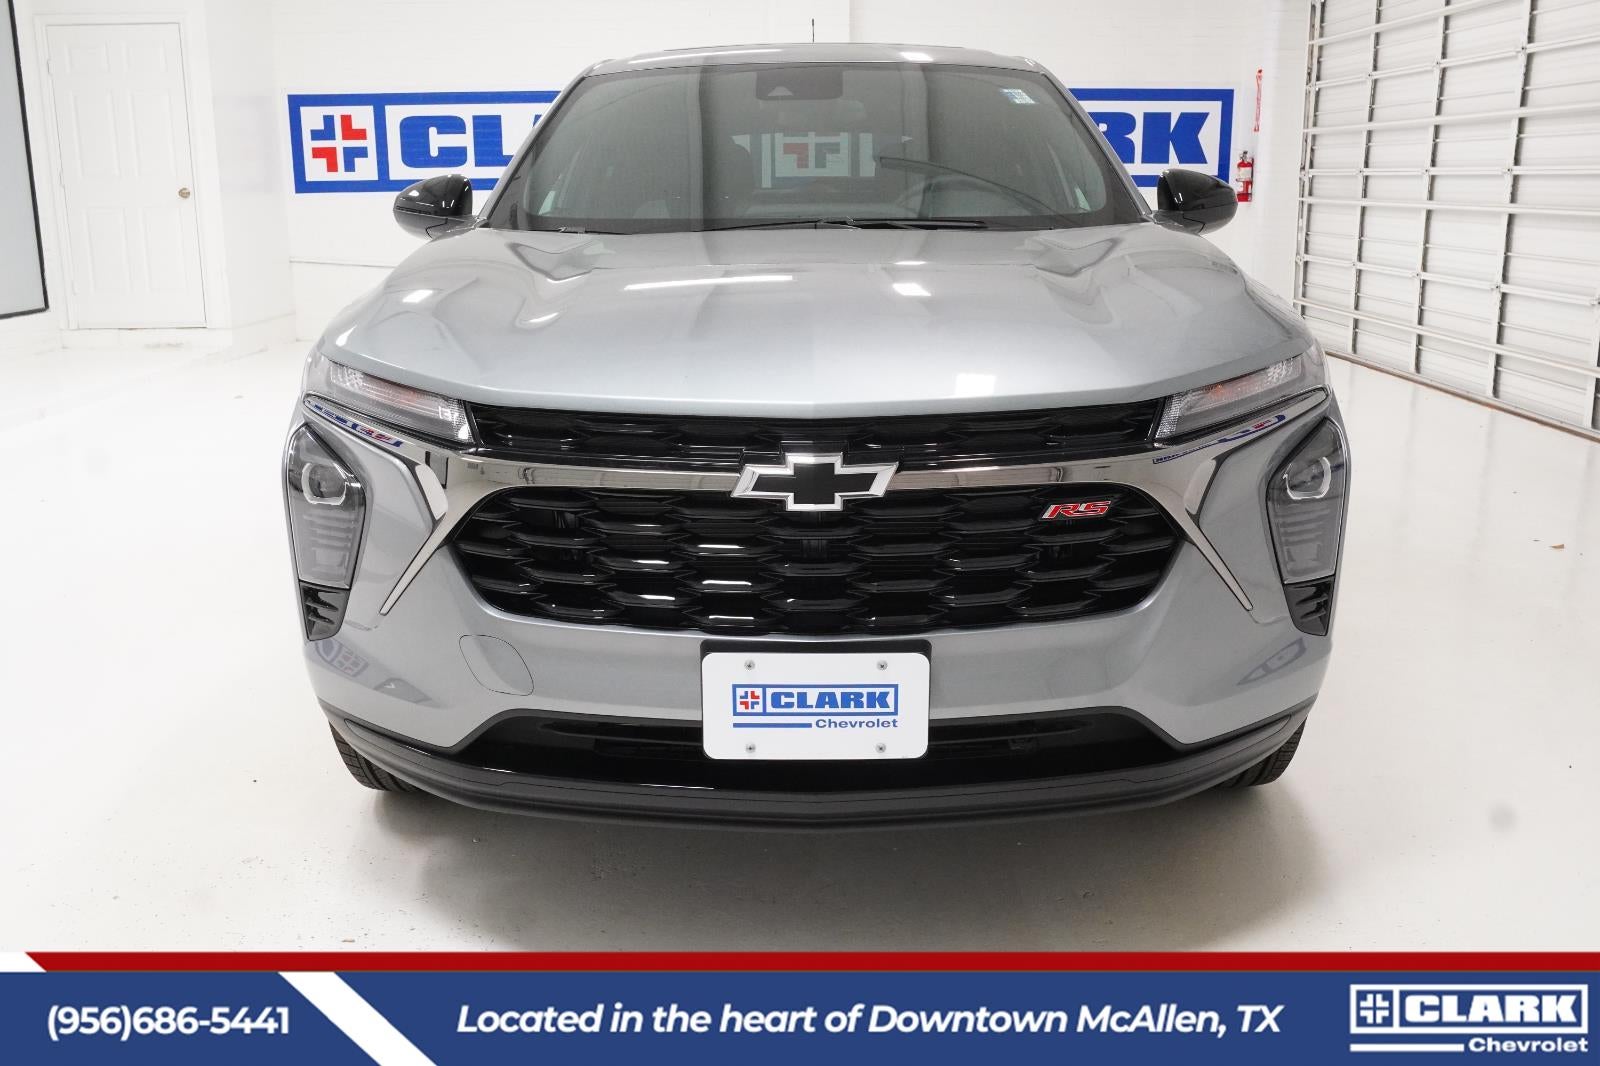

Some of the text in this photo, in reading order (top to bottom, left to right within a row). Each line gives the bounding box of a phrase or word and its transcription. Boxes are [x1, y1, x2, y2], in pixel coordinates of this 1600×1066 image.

[399, 114, 542, 168] CL
[1042, 500, 1112, 519] RS
[770, 691, 891, 710] CLARK
[815, 718, 899, 729] Chevrolet
